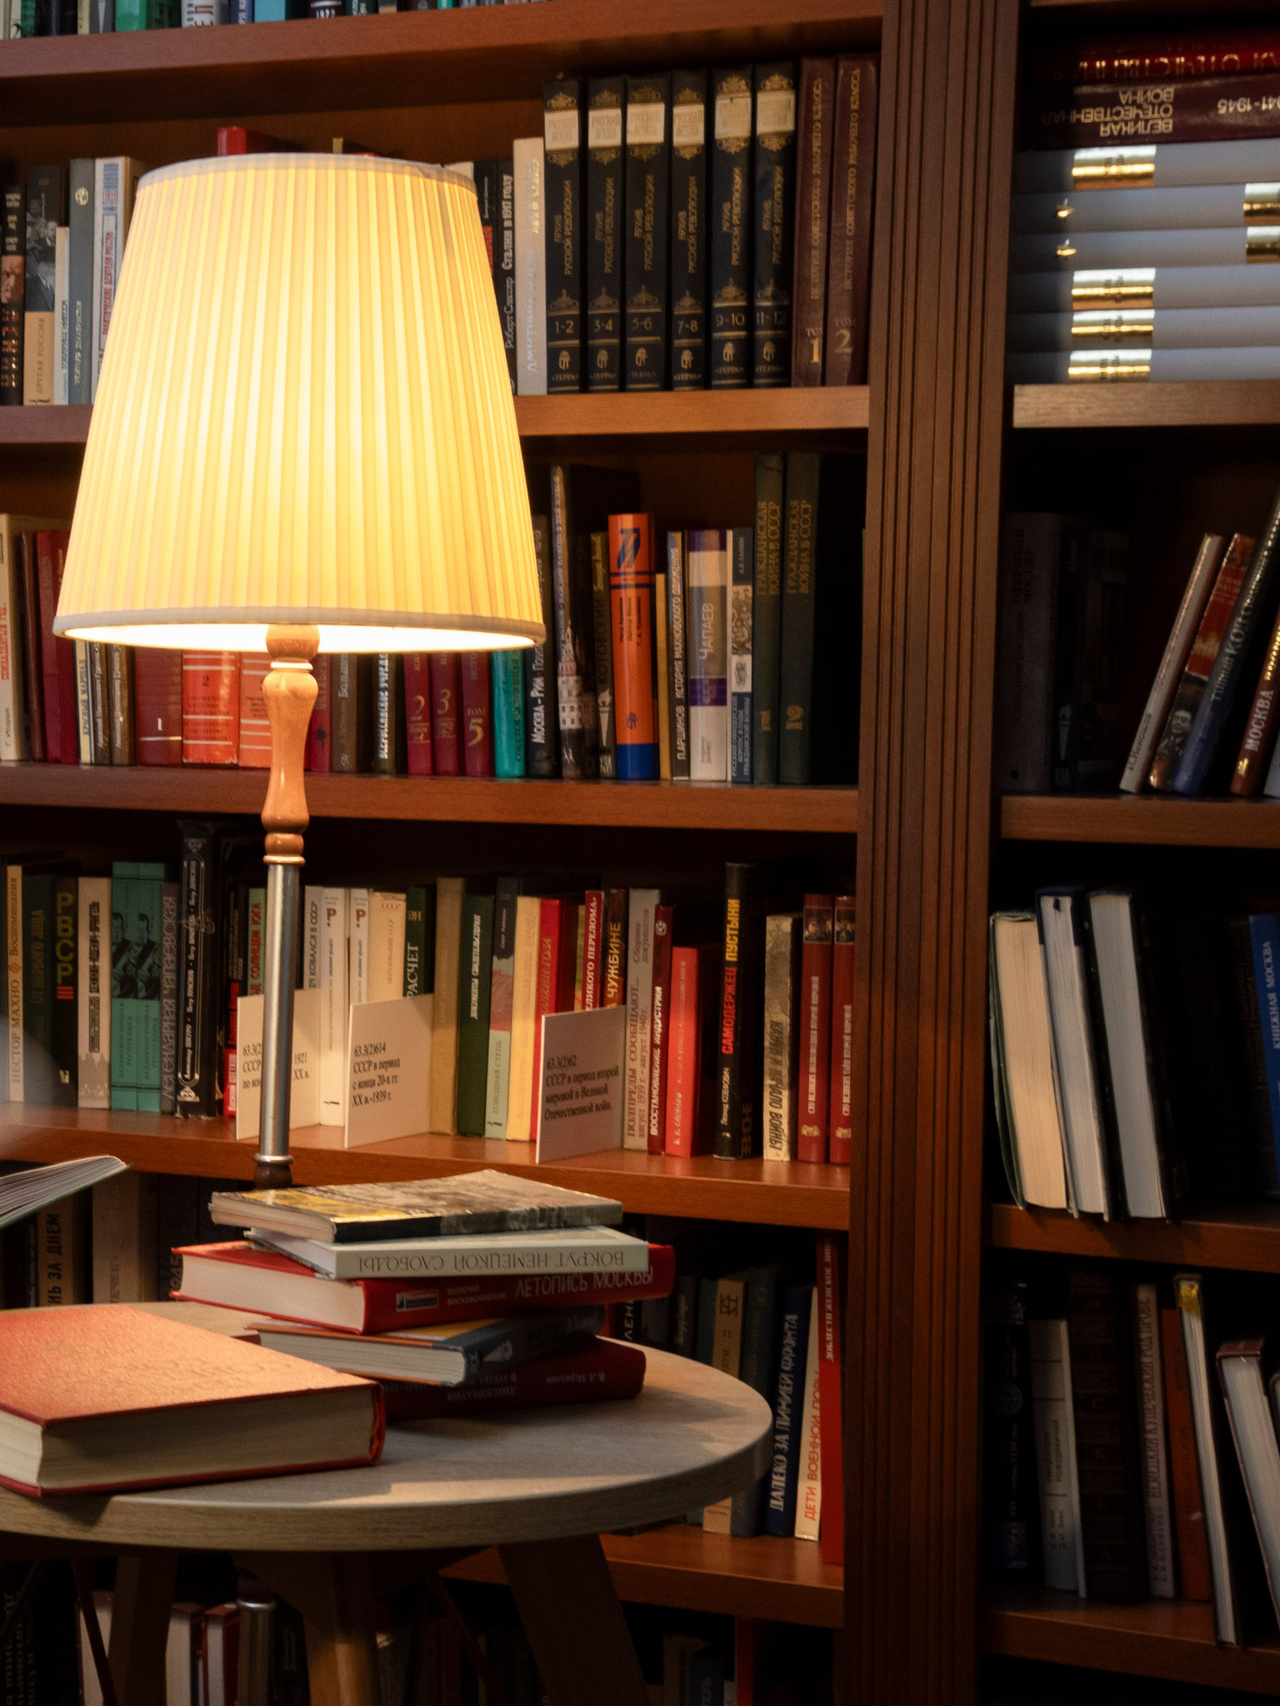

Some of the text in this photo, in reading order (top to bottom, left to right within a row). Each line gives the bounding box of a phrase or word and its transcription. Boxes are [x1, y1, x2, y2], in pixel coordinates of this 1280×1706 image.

[850, 68, 861, 110] КЛАССА
[1118, 86, 1175, 105] ВОЙНА
[1041, 104, 1174, 125] ОТЕЧЕСТВЕННАЯ
[1099, 118, 1173, 137] ВЕЛИКАЯ
[848, 111, 858, 165] РАБОЧЕГО
[845, 167, 857, 237] СОВЕТСКОГО
[501, 228, 514, 271] Сталин
[504, 314, 515, 349] Роберт
[553, 319, 574, 334] 1-2
[592, 318, 613, 333] 3-4
[632, 313, 653, 330] 5-6
[677, 319, 698, 334] 7-8
[715, 313, 746, 328] 9-10
[809, 336, 821, 365] 1
[834, 329, 853, 355] 2
[756, 501, 768, 596] ГРАЖДАНСКАЯ
[767, 501, 780, 595] ВОЙНА СССР
[787, 499, 799, 594] ГРАЖДАНСКАЯ
[799, 499, 811, 594] ВОЙНА СССР
[699, 602, 714, 660] ЧАПАЕВ
[201, 674, 210, 687] 2
[673, 660, 685, 698] ИСТОРИЯ
[410, 694, 426, 721] 2
[436, 687, 452, 715] 3
[784, 704, 804, 731] 2
[466, 717, 484, 748] 5
[759, 709, 772, 732] 1
[1244, 689, 1274, 752] МОСКВА
[8, 877, 19, 957] Воспоминания
[250, 901, 261, 980] СОЛНЦЕМ ЮГА
[308, 901, 319, 976] КОВАЛСЯ СССР
[631, 921, 641, 964] Сборник
[406, 942, 420, 998] РАСЧЕТ
[607, 921, 621, 998] ЧУЖБИНЕ
[722, 898, 740, 1055] САМОДЕРЖЕЦ ПУСТЫНИ
[1262, 941, 1280, 1050] КНИЖНАЯ МОСКВА
[9, 979, 21, 1082] НЕСТОР МАХНО
[293, 1052, 308, 1065] 1921
[293, 1068, 304, 1081] XX
[353, 1058, 401, 1075] СССР период
[649, 985, 663, 1136] ВОССТАНОВЛЕНИЕ ИНДУСТРИИ
[357, 1079, 376, 1091] конца
[545, 1066, 619, 1088] СССР период второй
[545, 1083, 609, 1106] мировой Великой
[352, 1094, 363, 1107] XX
[544, 1102, 593, 1121] Отечественной
[627, 1068, 637, 1138] ПОЛПРЕДЫ
[768, 1110, 782, 1150] ВОЙНЫ
[46, 1212, 62, 1281] ЗА ДНЕМ
[357, 1249, 625, 1274] ВОКРУГ НЕМЕЦКОЙ СЛОБОДЫ
[514, 1266, 654, 1299] ЛЕТОПИСЬ МОСКВЫ
[770, 1313, 799, 1512] ДАЛЕКО ЗА ЛИНИЕЙ ФРОНТА
[804, 1415, 821, 1521] ДЕТИ ВОЕННОЙ
